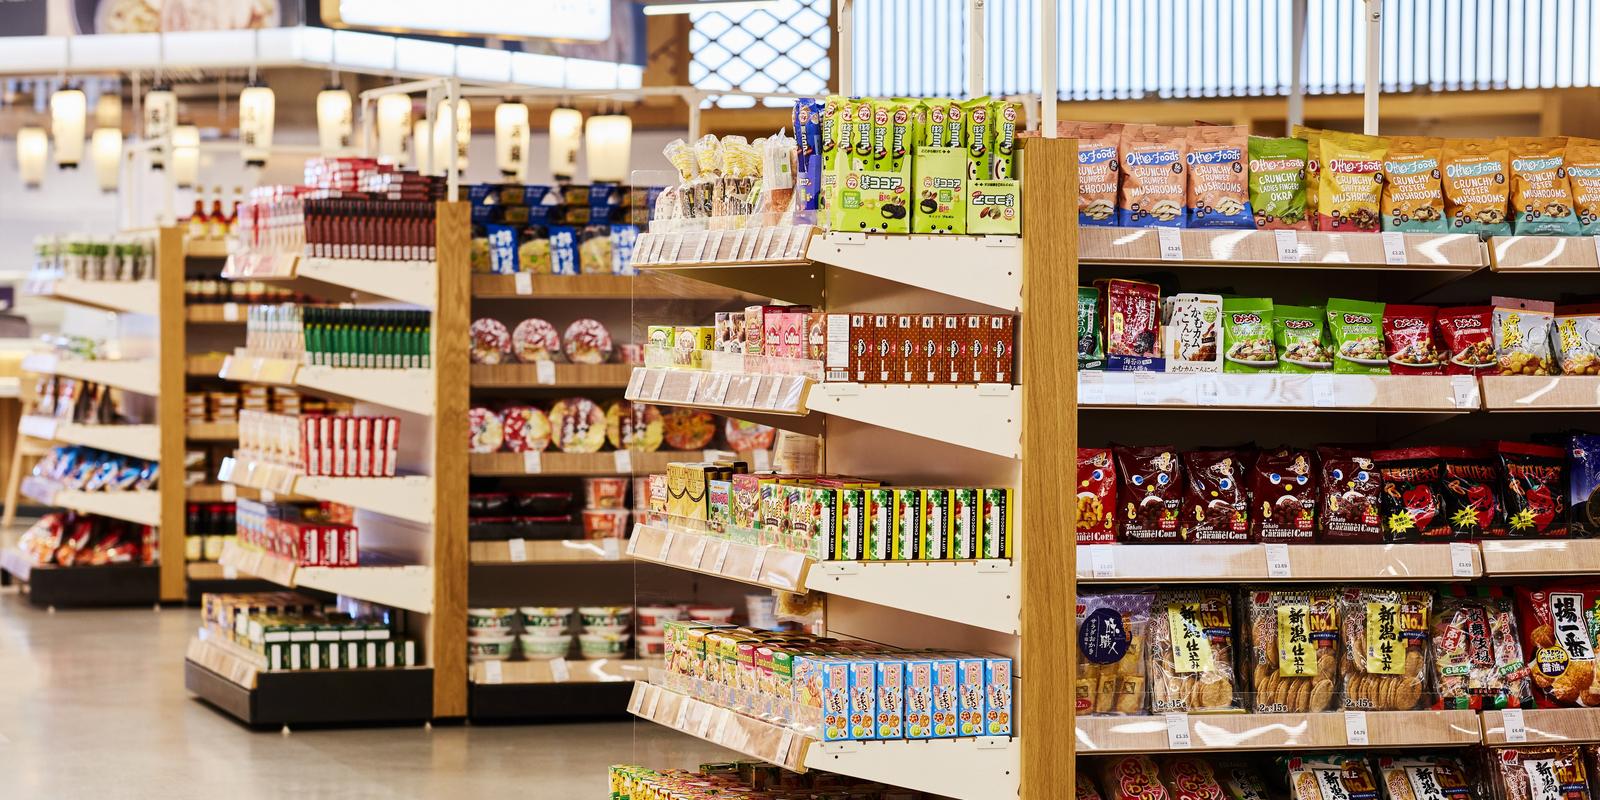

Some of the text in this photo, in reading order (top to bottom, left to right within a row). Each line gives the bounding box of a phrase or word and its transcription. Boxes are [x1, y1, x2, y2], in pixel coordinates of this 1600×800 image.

[1134, 167, 1171, 178] CRUNCHY
[1195, 164, 1232, 175] CRUNCHY
[1139, 176, 1169, 185] TRUMPET
[1201, 173, 1231, 182] TRUMPET
[1258, 172, 1298, 184] CRUNCHY
[1336, 174, 1374, 186] CRUNCHY
[1392, 174, 1430, 186] CRUNCHY
[1453, 176, 1494, 190] CRUNCHY
[1522, 172, 1558, 182] CRUNCHY
[1131, 184, 1183, 197] MUSHROOMS
[1194, 183, 1242, 195] MUSHROOMS
[1400, 183, 1427, 193] OYSTER
[1462, 185, 1490, 195] OYSTER
[1522, 188, 1568, 200] MUSHROOMS
[1271, 191, 1294, 201] OKRA
[1332, 191, 1377, 204] MUSHROOMS
[1392, 189, 1441, 202] MUSHROOMS
[1453, 194, 1506, 206] MUSHROOMS
[1190, 307, 1204, 348] かむカム
[1262, 529, 1313, 537] Caramel Corn
[1329, 521, 1379, 533] Caramel Corn
[1094, 531, 1113, 541] Corn
[1126, 529, 1176, 538] Caramel Corn
[1196, 531, 1247, 540] Caramel Corn
[1203, 606, 1231, 627] No.1
[1311, 607, 1338, 631] No.1
[1402, 607, 1428, 630] No.1
[1554, 597, 1589, 657] 揚一番
[1100, 616, 1119, 655] 味職人
[1289, 607, 1307, 674] 新潟仕込み
[1379, 605, 1396, 671] 新潟仕込み
[1558, 758, 1585, 784] No.1
